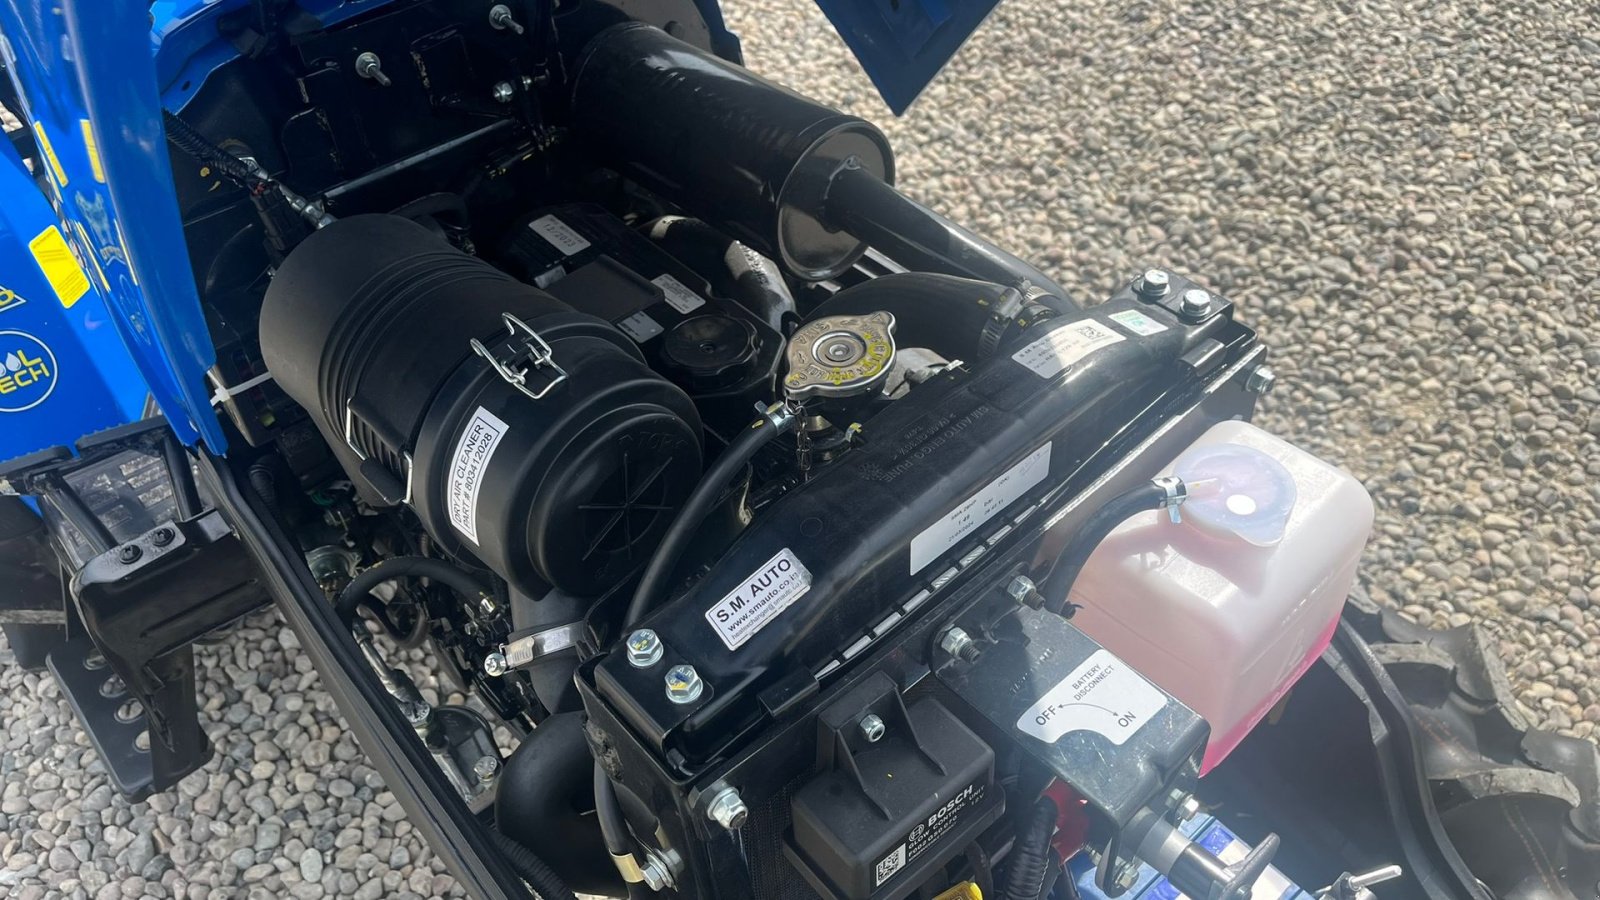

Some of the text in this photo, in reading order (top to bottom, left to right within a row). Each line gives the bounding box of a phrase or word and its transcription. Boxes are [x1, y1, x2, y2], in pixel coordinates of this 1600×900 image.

[453, 424, 484, 523] DRY AIR CLEANER
[465, 432, 493, 491] 803412028
[462, 501, 471, 529] PART
[716, 559, 791, 623] S.M. AUTO
[1072, 663, 1102, 690] BATTERY
[1073, 664, 1115, 701] DISCONNECT
[1035, 705, 1058, 726] OFF
[1117, 711, 1137, 728] ON
[908, 830, 931, 849] GLOW
[932, 801, 966, 830] CONTROL
[968, 785, 985, 801] UNIT
[928, 785, 973, 827] BOSCH
